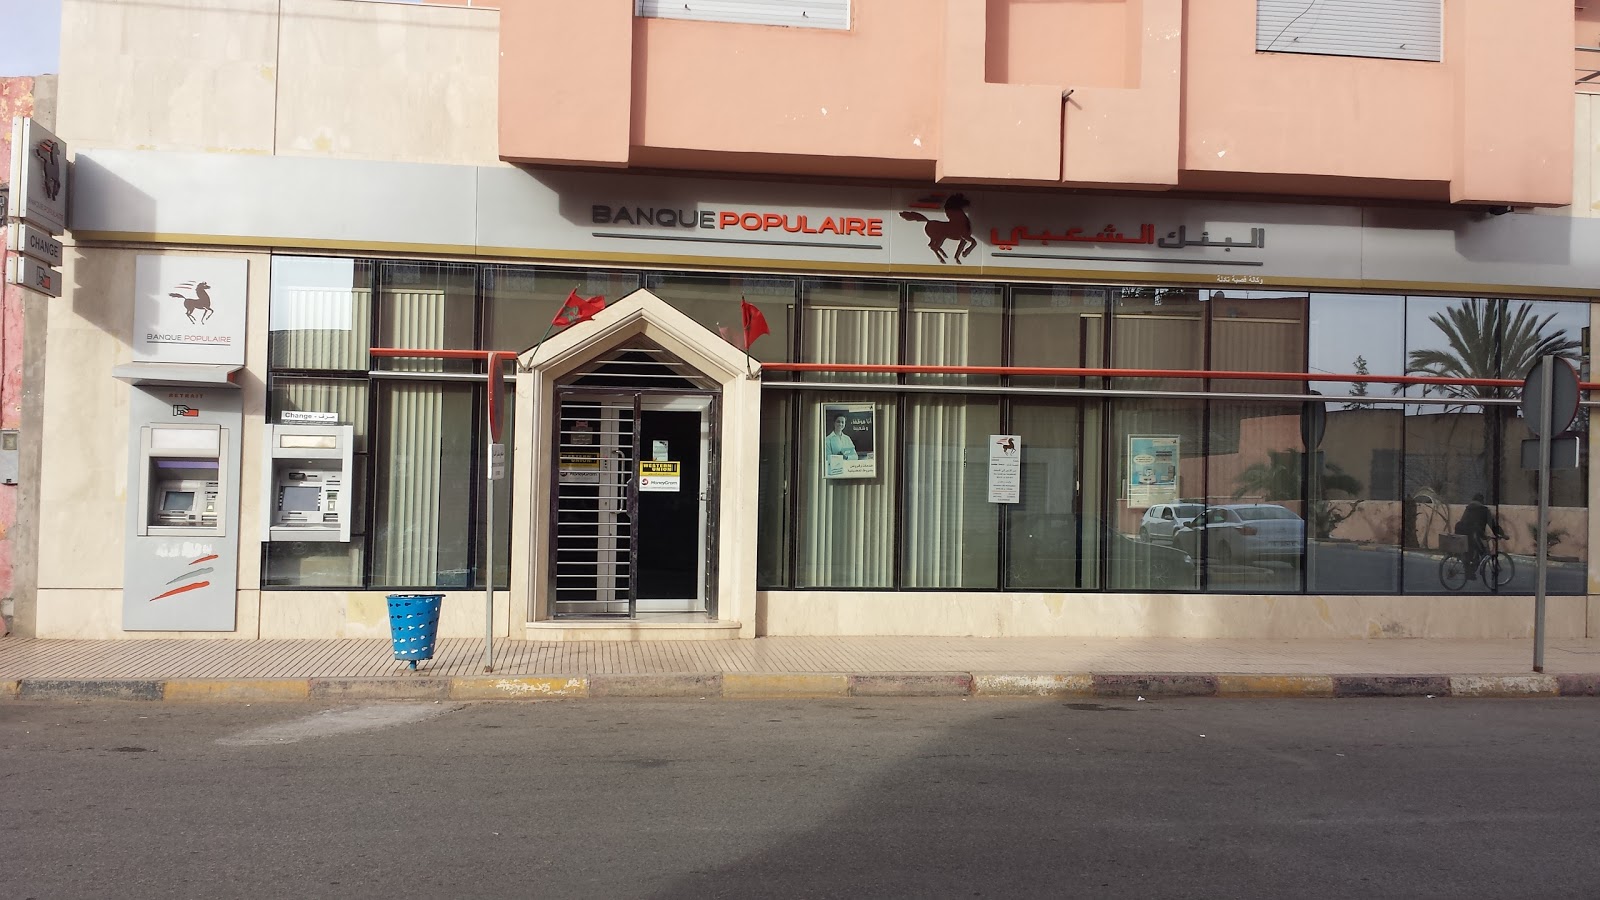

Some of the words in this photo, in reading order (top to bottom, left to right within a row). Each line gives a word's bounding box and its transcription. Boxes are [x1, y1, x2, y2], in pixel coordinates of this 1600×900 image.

[592, 205, 716, 229] BANQUE
[719, 210, 883, 237] POPULAIRE
[30, 235, 59, 258] CHANGE
[990, 223, 1155, 251] الشعبي
[1157, 224, 1265, 252] البنك
[1248, 275, 1263, 285] وكالة
[146, 333, 182, 341] BANQUE
[184, 335, 231, 343] POPULAIRE
[285, 412, 313, 420] Change
